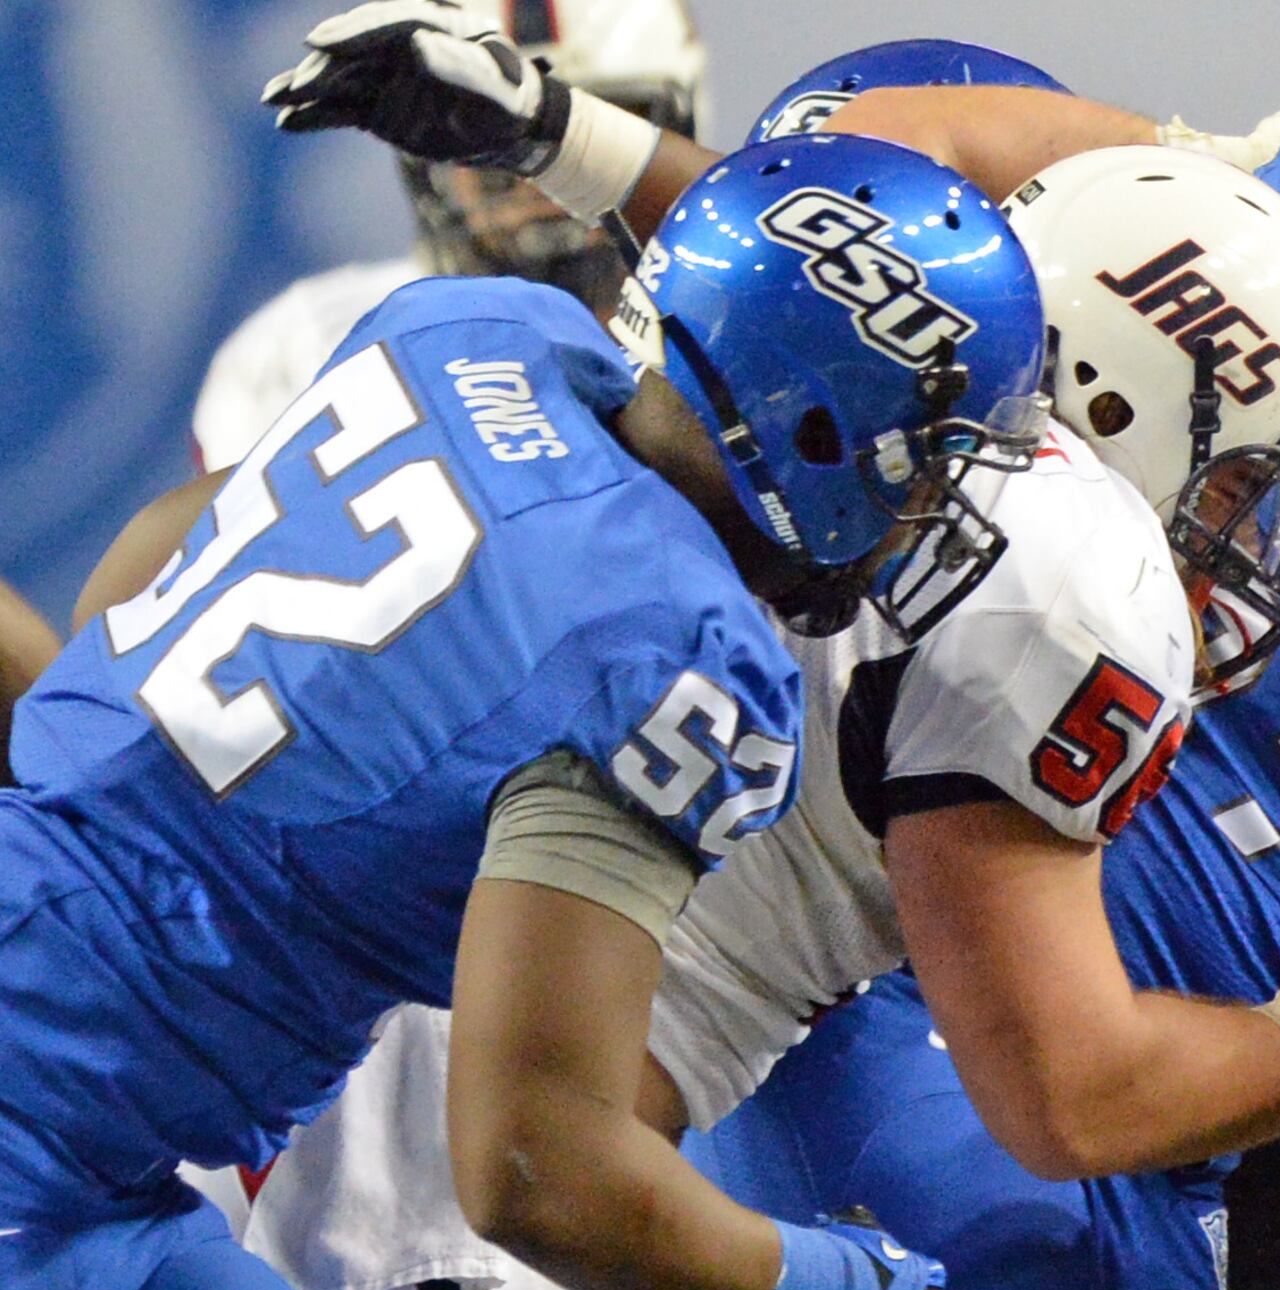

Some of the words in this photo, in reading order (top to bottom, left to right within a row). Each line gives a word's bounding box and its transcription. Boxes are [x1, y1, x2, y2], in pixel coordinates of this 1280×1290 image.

[756, 186, 979, 370] GSU
[445, 357, 569, 464] JONES
[102, 340, 483, 801] 52
[608, 667, 802, 860] 52
